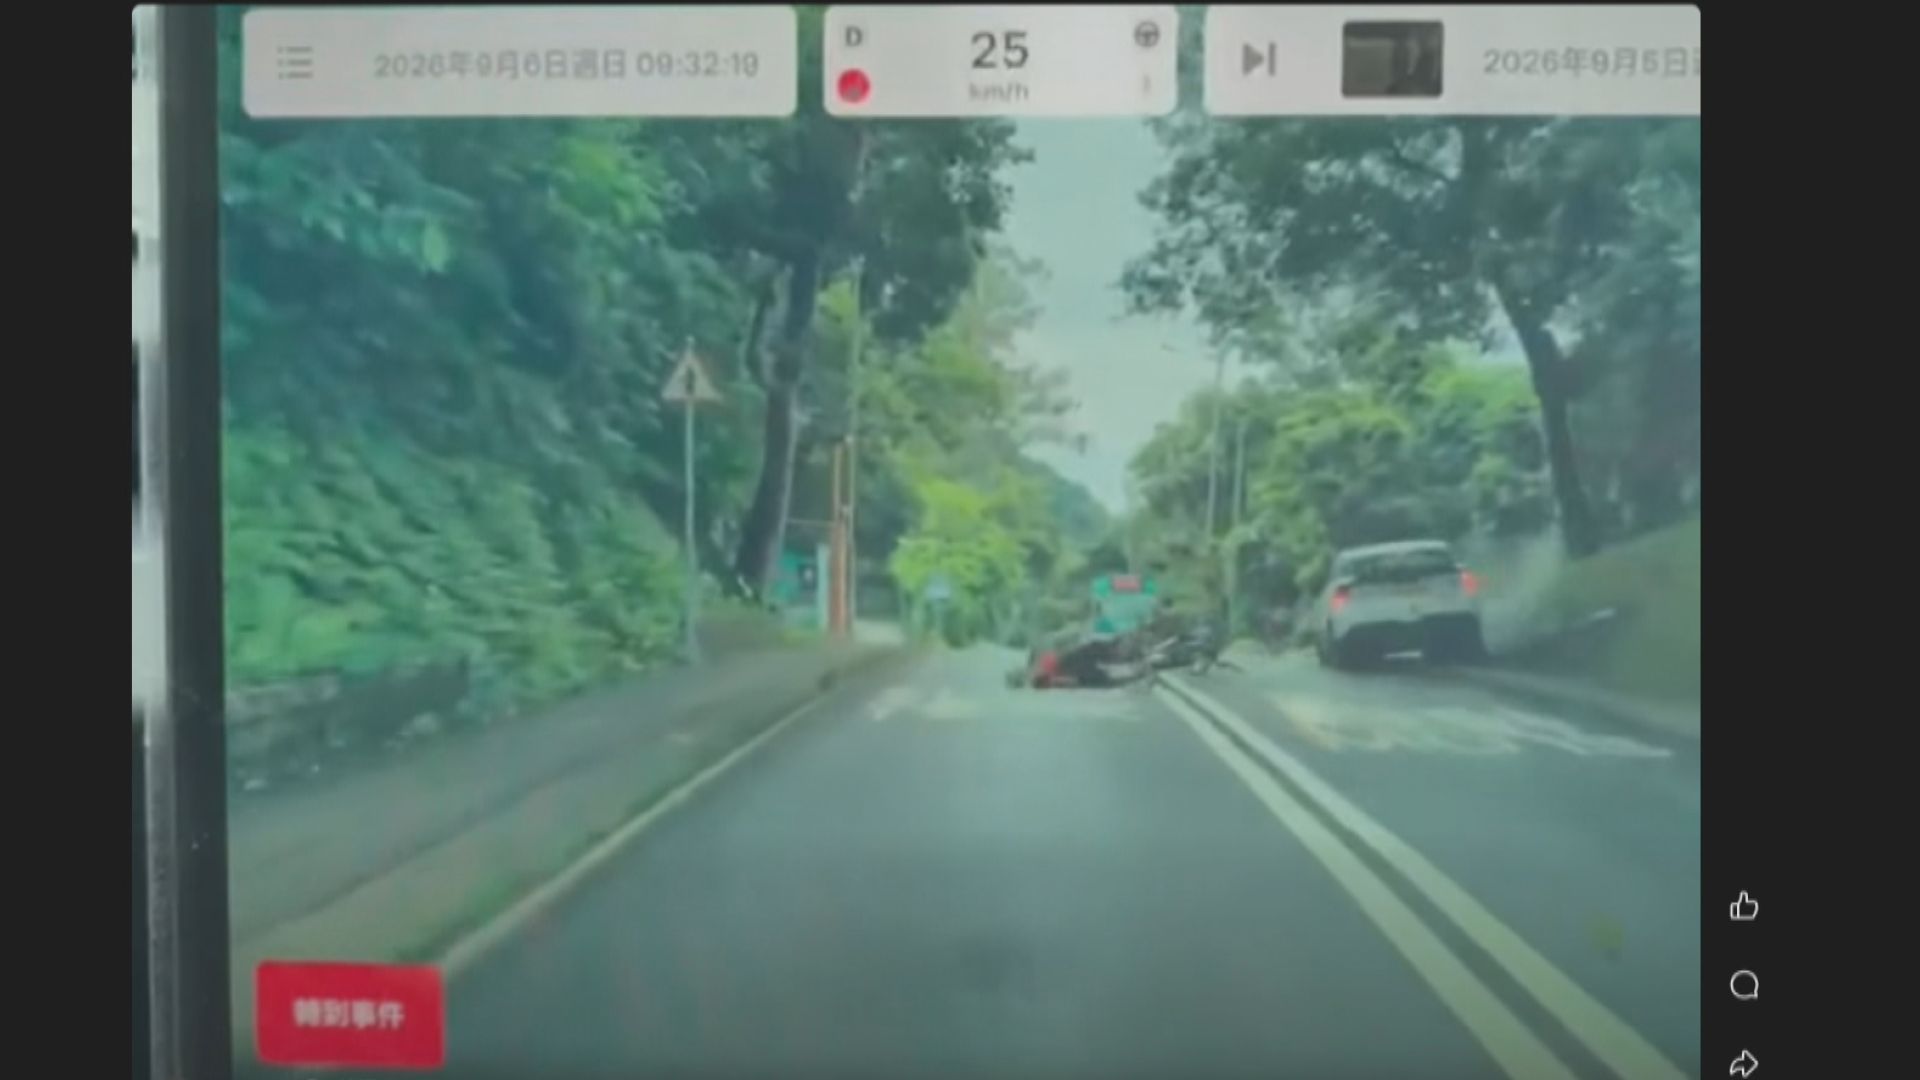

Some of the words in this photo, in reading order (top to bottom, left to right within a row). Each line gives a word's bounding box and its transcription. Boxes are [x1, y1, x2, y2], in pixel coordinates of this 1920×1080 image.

[845, 26, 863, 47] D
[971, 30, 1029, 69] 25
[1482, 46, 1700, 78] 2026年9月5日
[968, 82, 1030, 102] km/h
